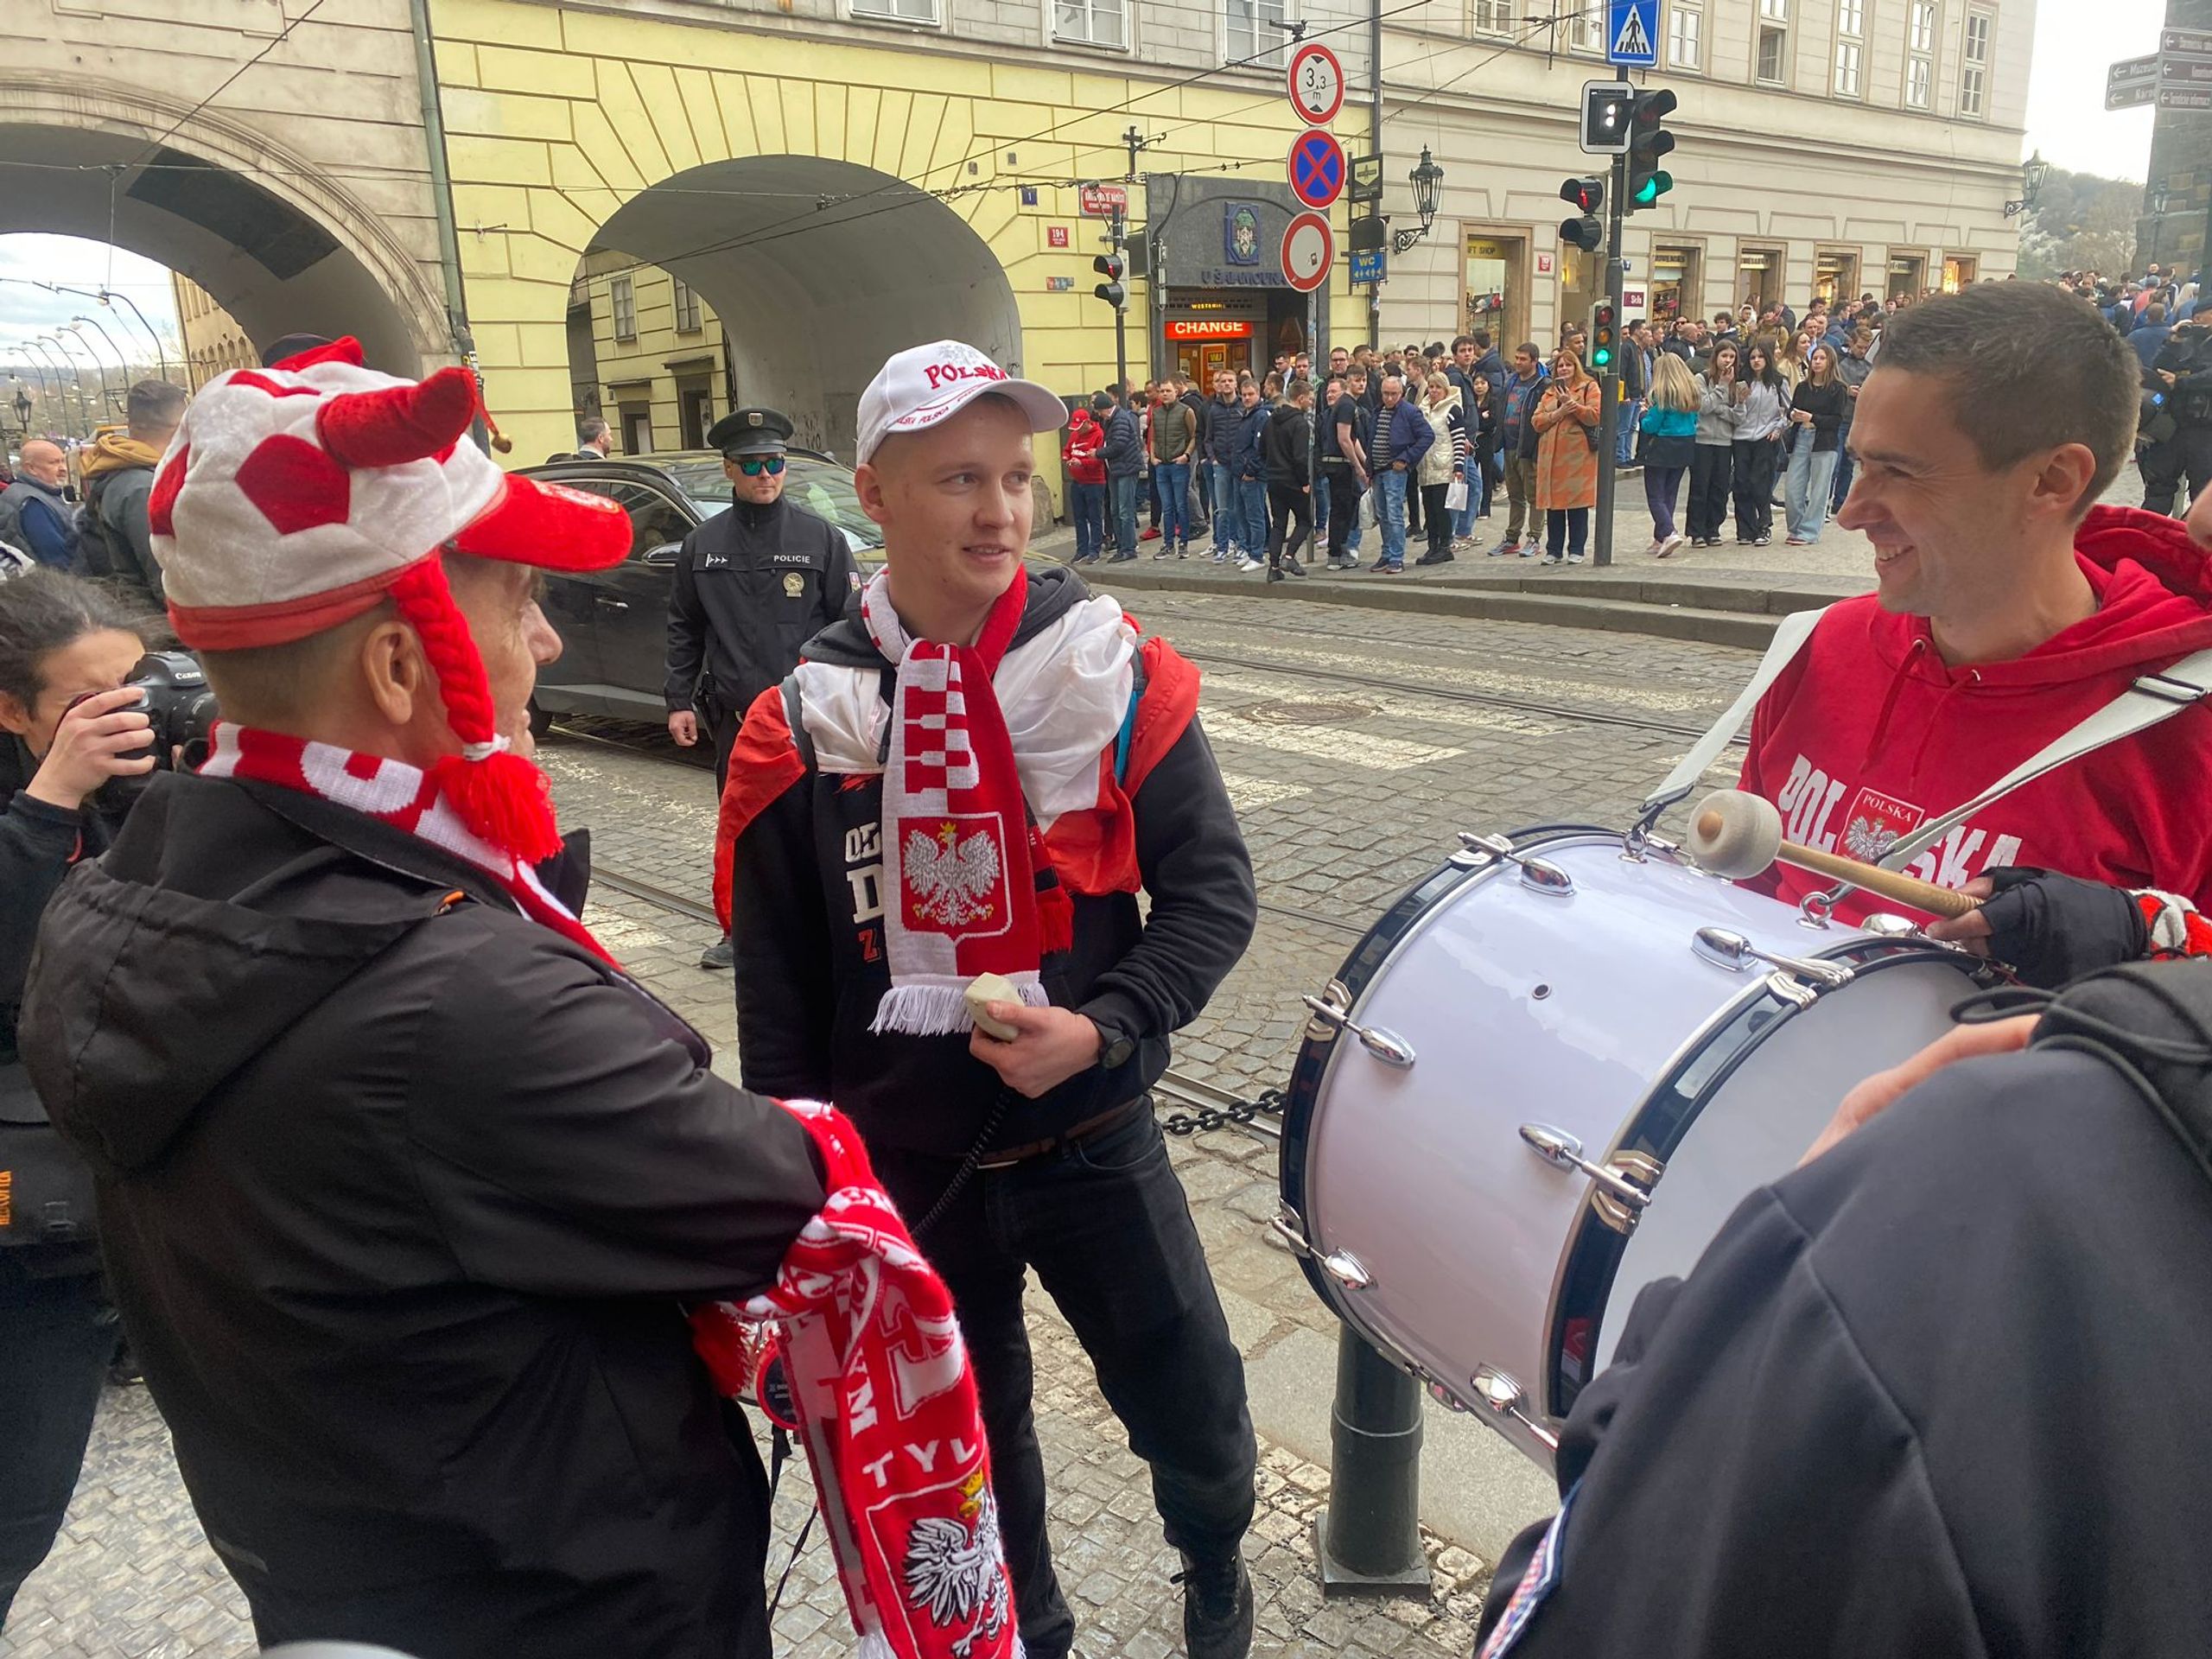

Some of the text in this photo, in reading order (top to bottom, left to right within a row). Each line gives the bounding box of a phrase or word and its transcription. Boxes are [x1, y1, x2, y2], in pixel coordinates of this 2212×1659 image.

[1052, 228, 1065, 238] 194
[1479, 246, 1495, 255] SHOP
[1358, 256, 1376, 267] WC
[1201, 270, 1210, 284] U
[1174, 321, 1243, 334] CHANGE
[924, 363, 1007, 390] POLSKA
[773, 555, 810, 564] POLICIE
[175, 671, 201, 680] Canon
[1863, 794, 1912, 823] POLSKA
